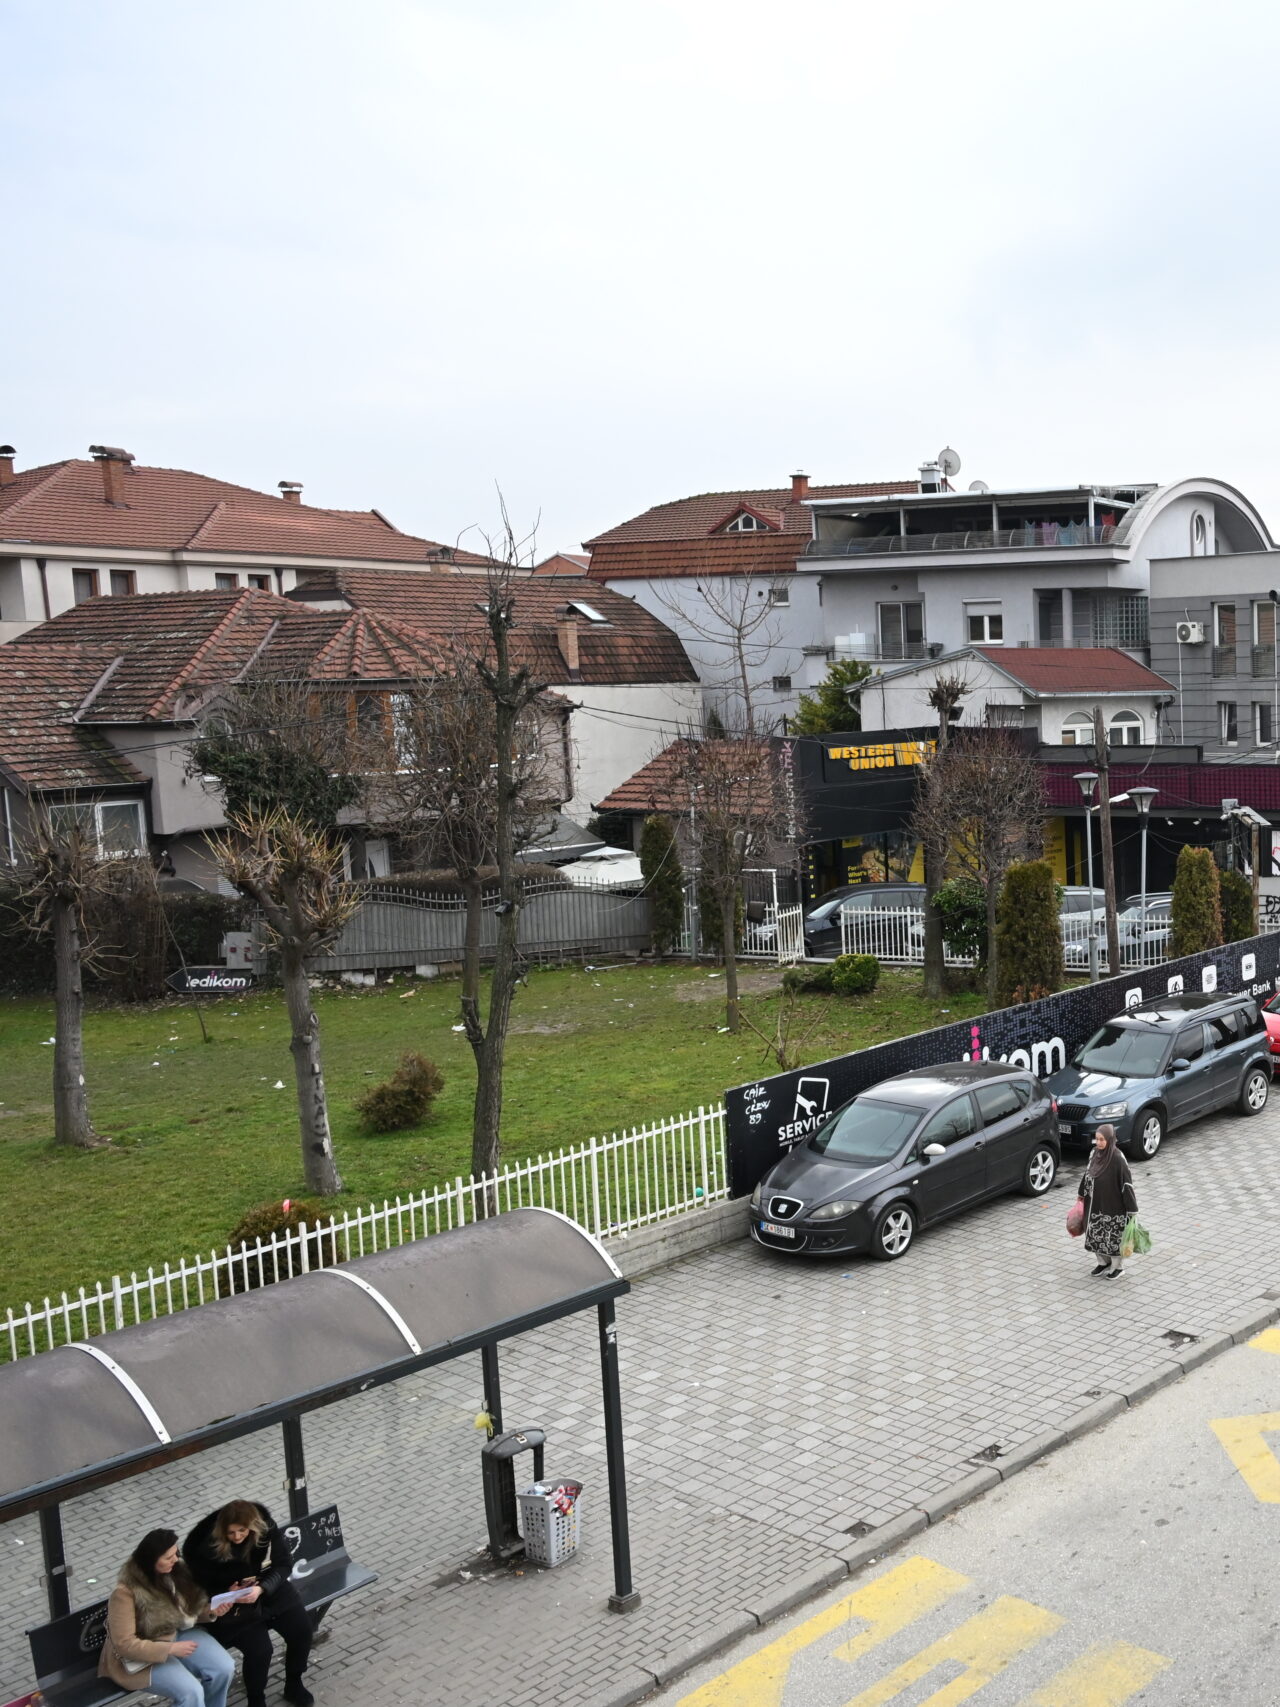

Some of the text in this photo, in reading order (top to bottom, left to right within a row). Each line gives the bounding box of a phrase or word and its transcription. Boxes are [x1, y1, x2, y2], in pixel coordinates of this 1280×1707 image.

[828, 743, 894, 759] WESTERN
[849, 756, 895, 770] UNION
[186, 970, 246, 987] ledikom
[1252, 980, 1271, 996] Bank
[749, 1113, 761, 1124] 89
